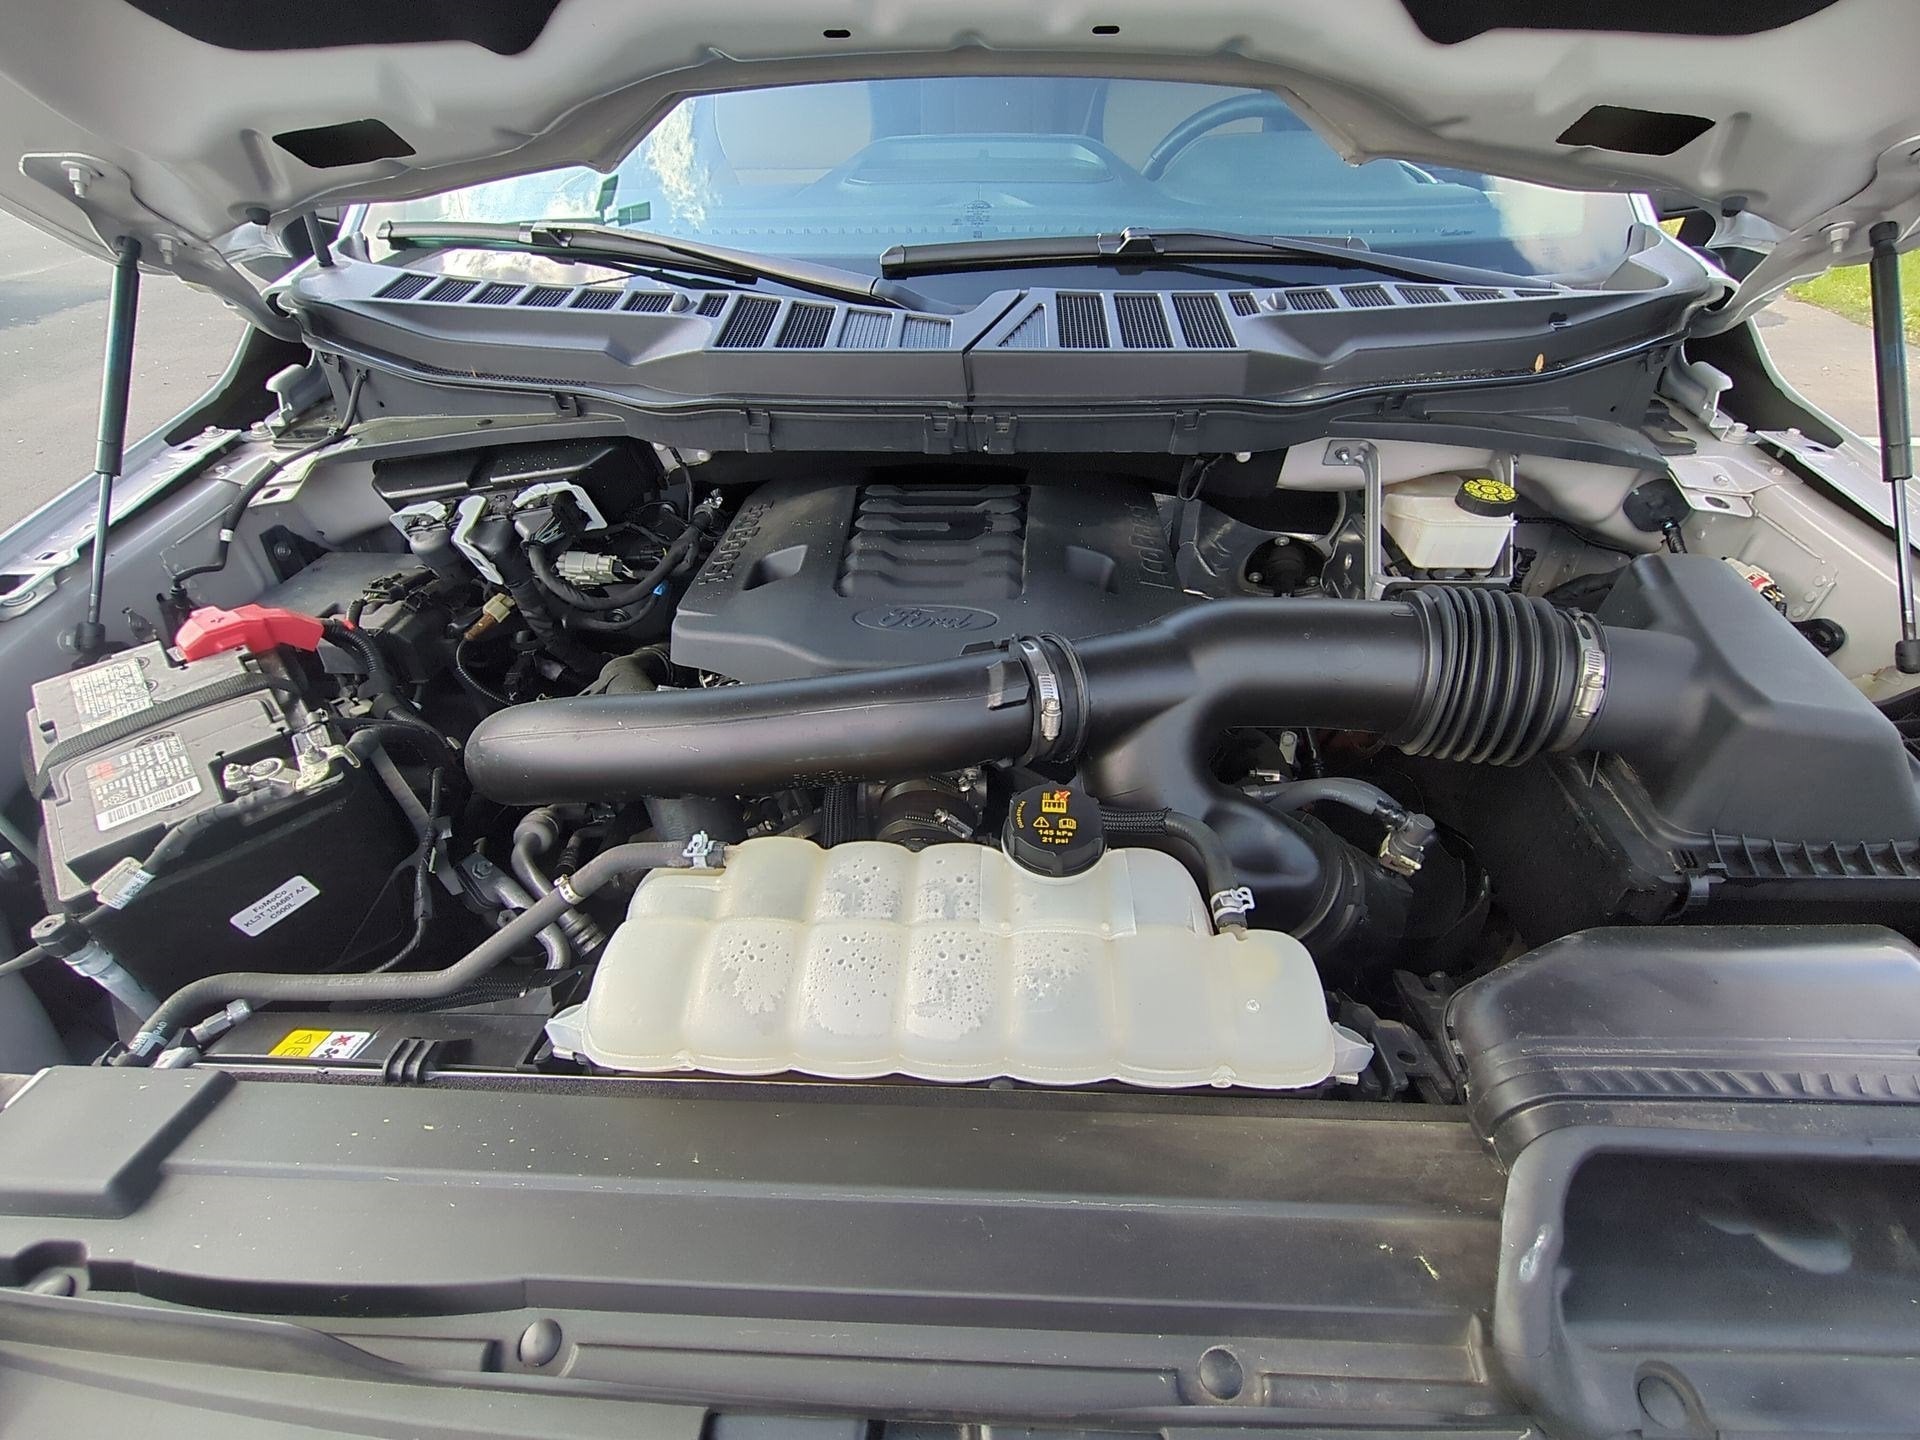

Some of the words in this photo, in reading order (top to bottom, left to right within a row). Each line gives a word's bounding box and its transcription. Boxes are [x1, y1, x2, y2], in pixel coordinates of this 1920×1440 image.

[878, 606, 974, 629] Ford
[1055, 837, 1069, 845] psi
[243, 912, 267, 928] KL3T
[296, 885, 308, 895] AA
[252, 890, 287, 913] FoMoCo
